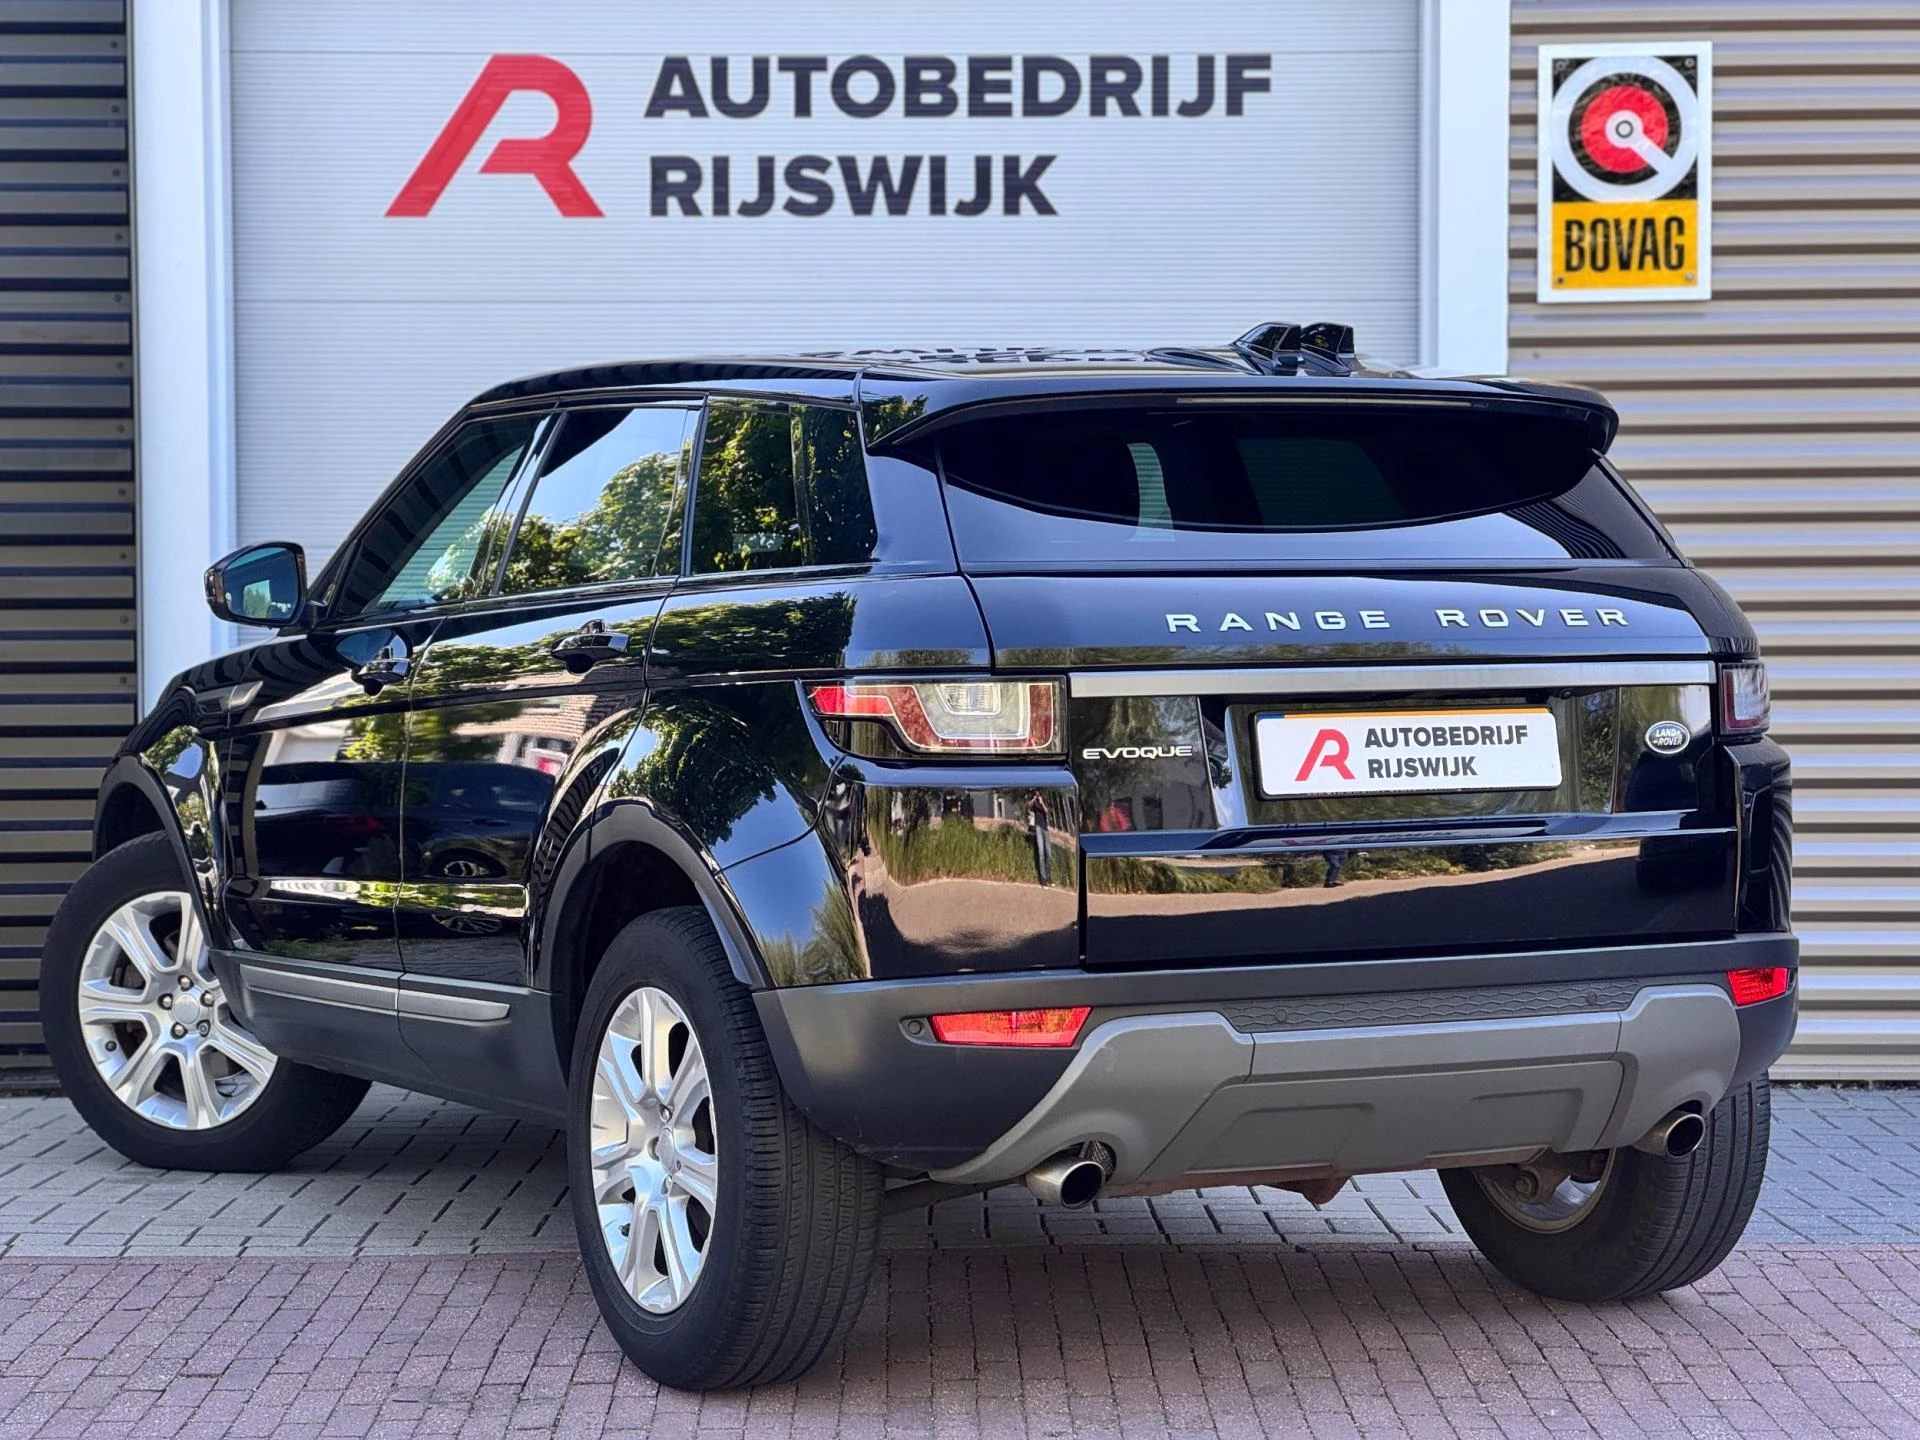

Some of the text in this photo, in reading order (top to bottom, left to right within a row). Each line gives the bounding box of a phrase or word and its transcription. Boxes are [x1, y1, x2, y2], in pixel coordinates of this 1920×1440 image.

[643, 53, 1273, 120] AUTOBEDRIJF
[649, 153, 1058, 217] RIJSWIJK
[1564, 216, 1686, 273] BOVAG
[1165, 607, 1630, 634] RANGE ROVER
[1364, 724, 1529, 749] AUTOBEDRIJF
[1655, 728, 1677, 738] LAND
[1657, 737, 1683, 747] ROVER
[1082, 745, 1193, 760] EVOQUE
[1367, 755, 1478, 779] RIJSWIJK
